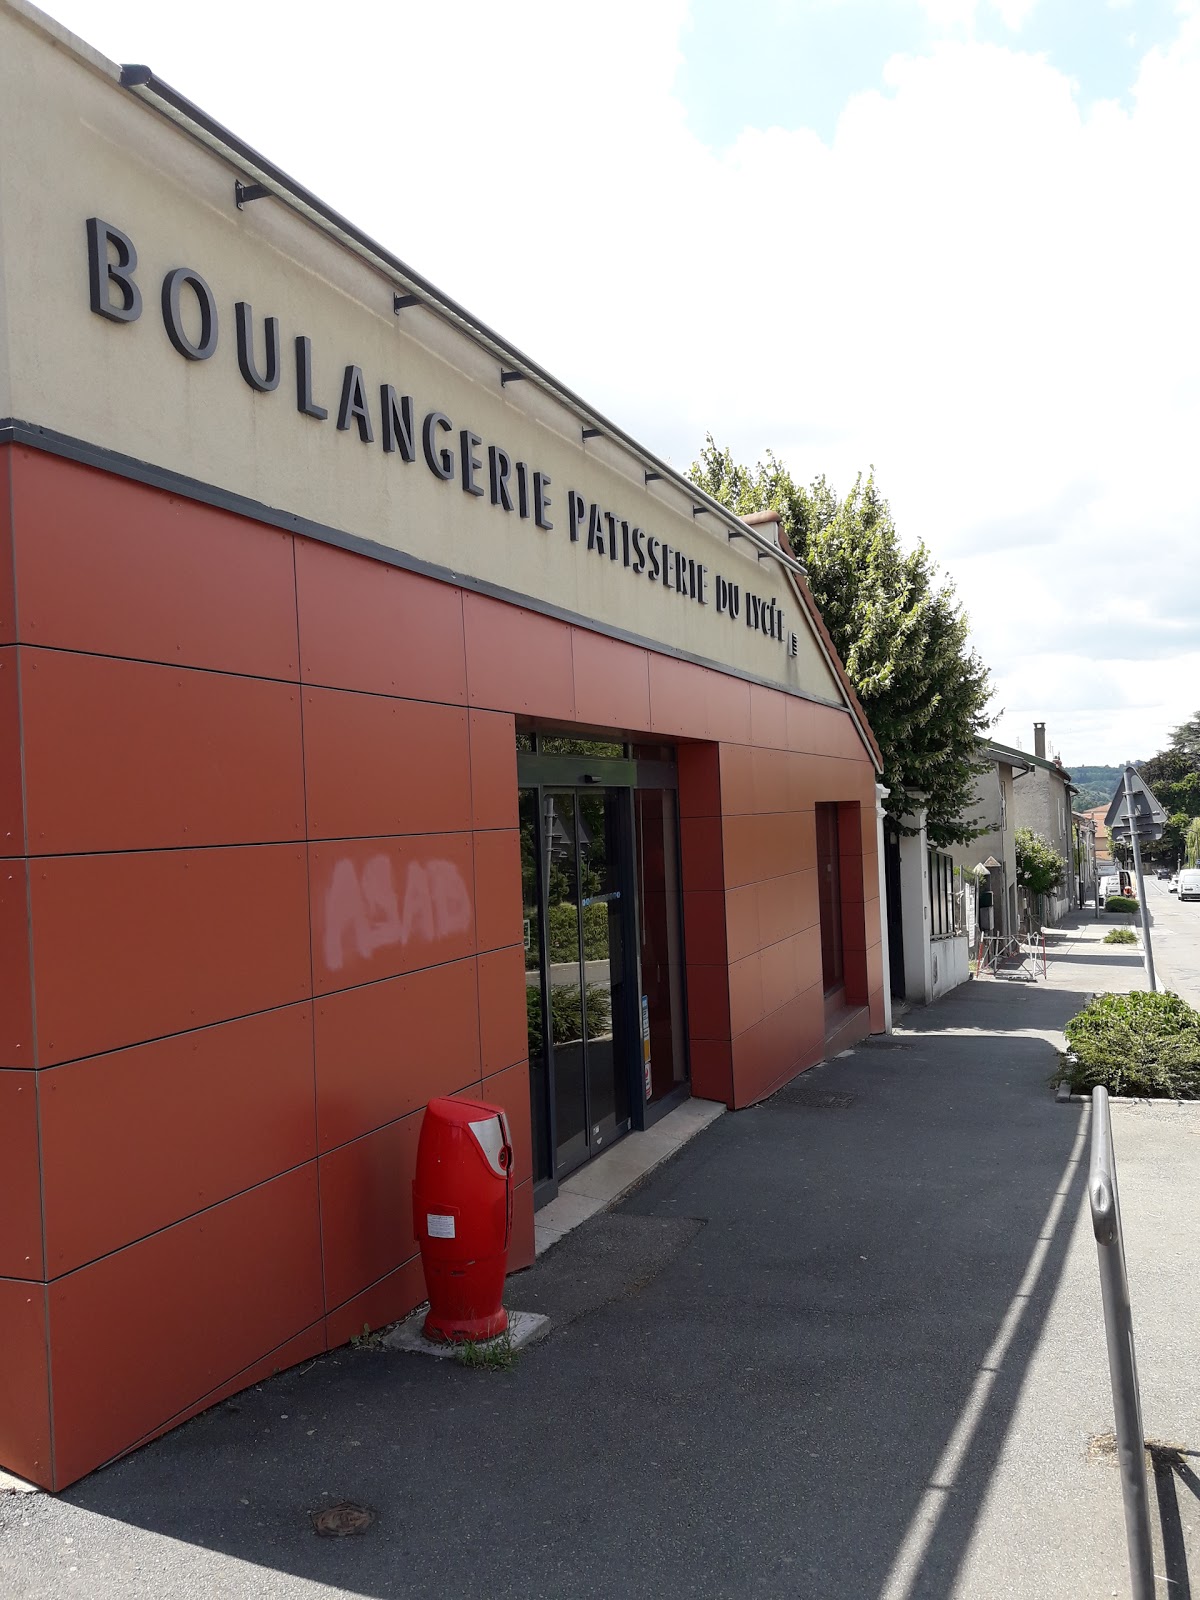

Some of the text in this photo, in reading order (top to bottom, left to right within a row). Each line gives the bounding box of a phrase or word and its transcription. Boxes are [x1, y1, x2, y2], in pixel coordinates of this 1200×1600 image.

[86, 217, 785, 642] BOULANGERIE PATISSERIE DU LYCÉE
